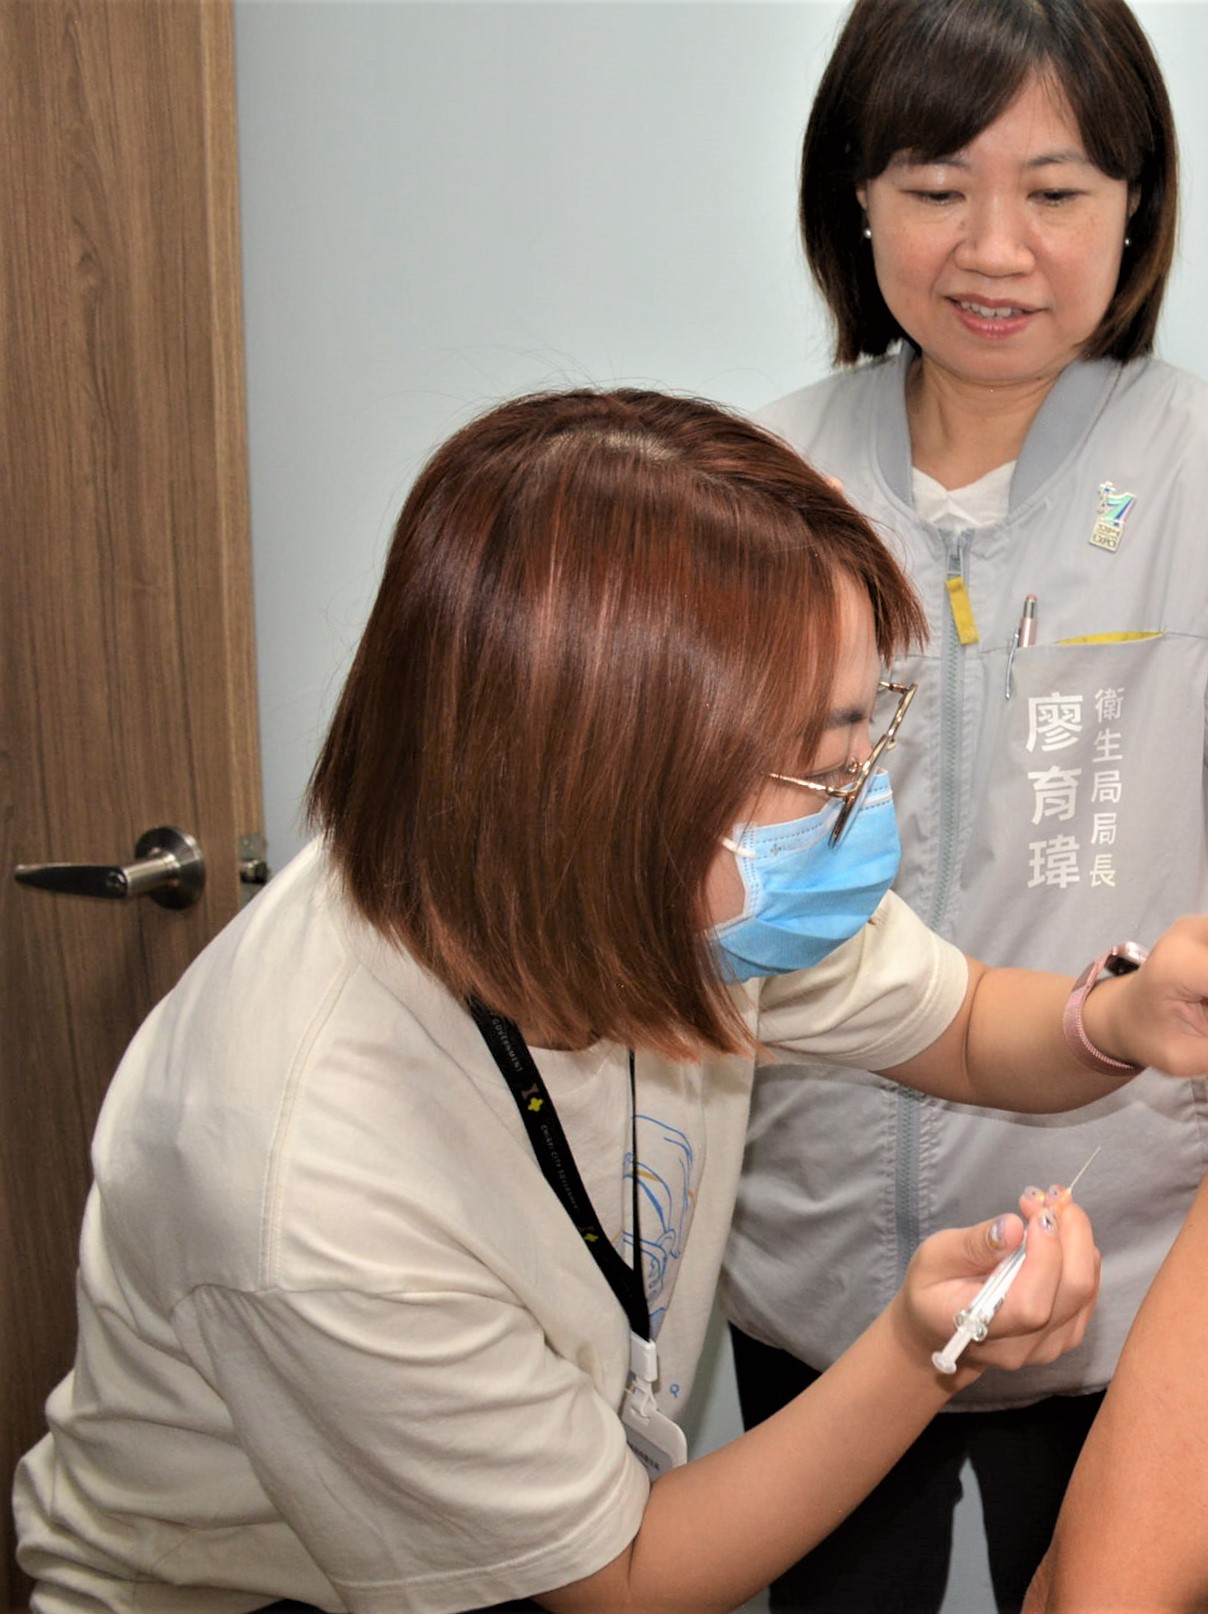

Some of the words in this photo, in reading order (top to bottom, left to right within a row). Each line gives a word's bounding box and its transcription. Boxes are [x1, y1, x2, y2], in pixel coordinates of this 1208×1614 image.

[1025, 691, 1083, 889] 廖育瑋
[1088, 687, 1125, 888] 衛生局局長
[491, 1017, 524, 1073] GOVERNMENT
